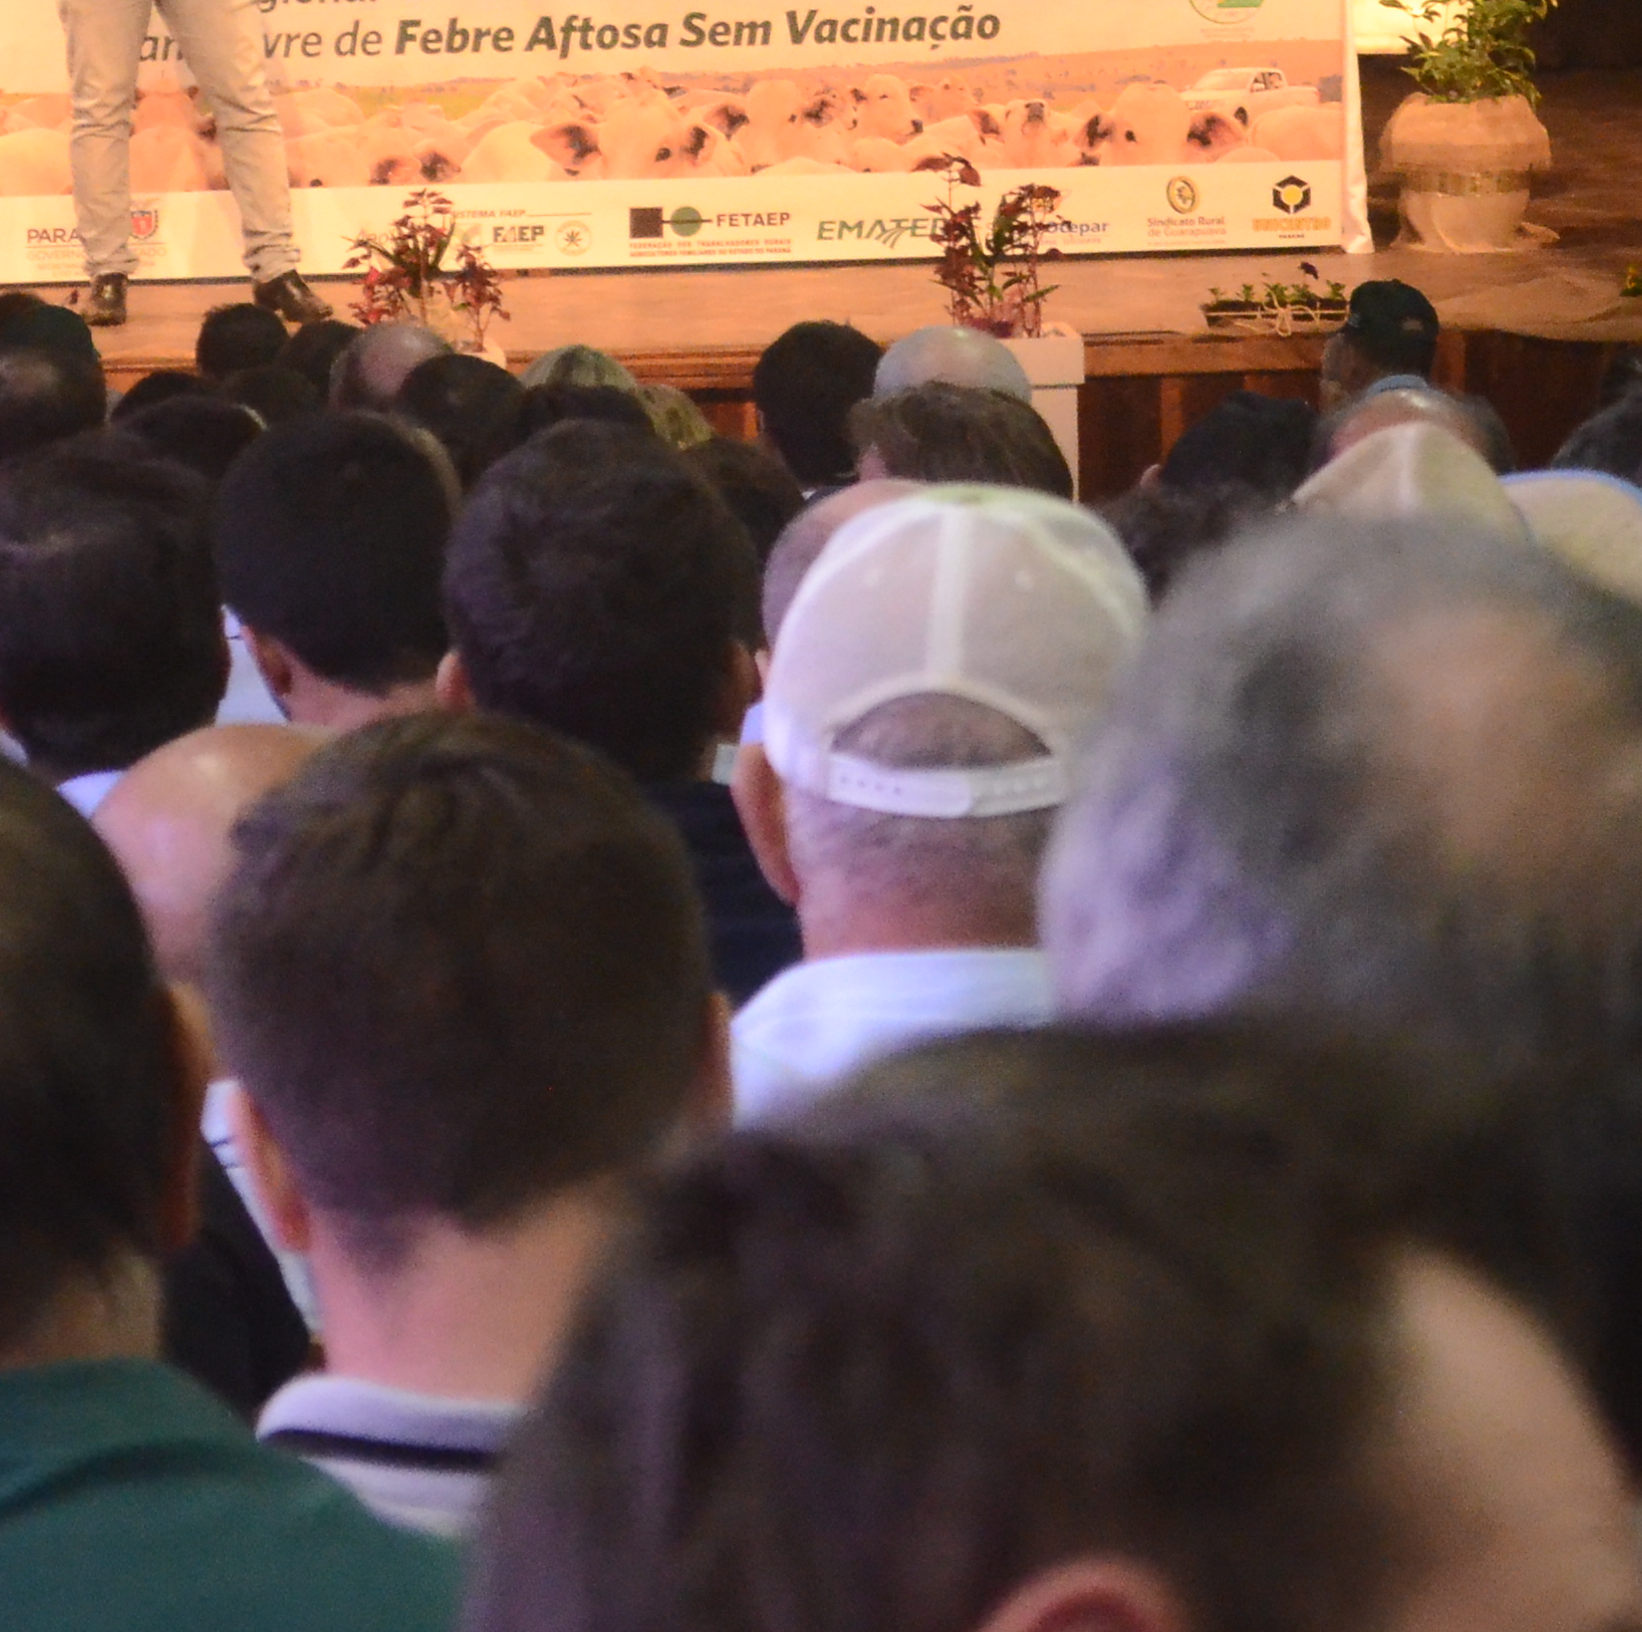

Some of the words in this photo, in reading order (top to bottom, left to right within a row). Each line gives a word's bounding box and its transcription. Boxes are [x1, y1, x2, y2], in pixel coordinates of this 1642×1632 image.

[262, 29, 323, 59] vre
[333, 19, 383, 57] de
[394, 16, 515, 56] Febre
[523, 14, 670, 60] Aftosa
[678, 11, 773, 48] Sem
[785, 4, 1002, 51] Vacinação
[716, 211, 791, 227] FETAEP
[1147, 217, 1196, 227] Sindicato
[1198, 215, 1226, 226] Rural
[26, 227, 80, 245] PARA
